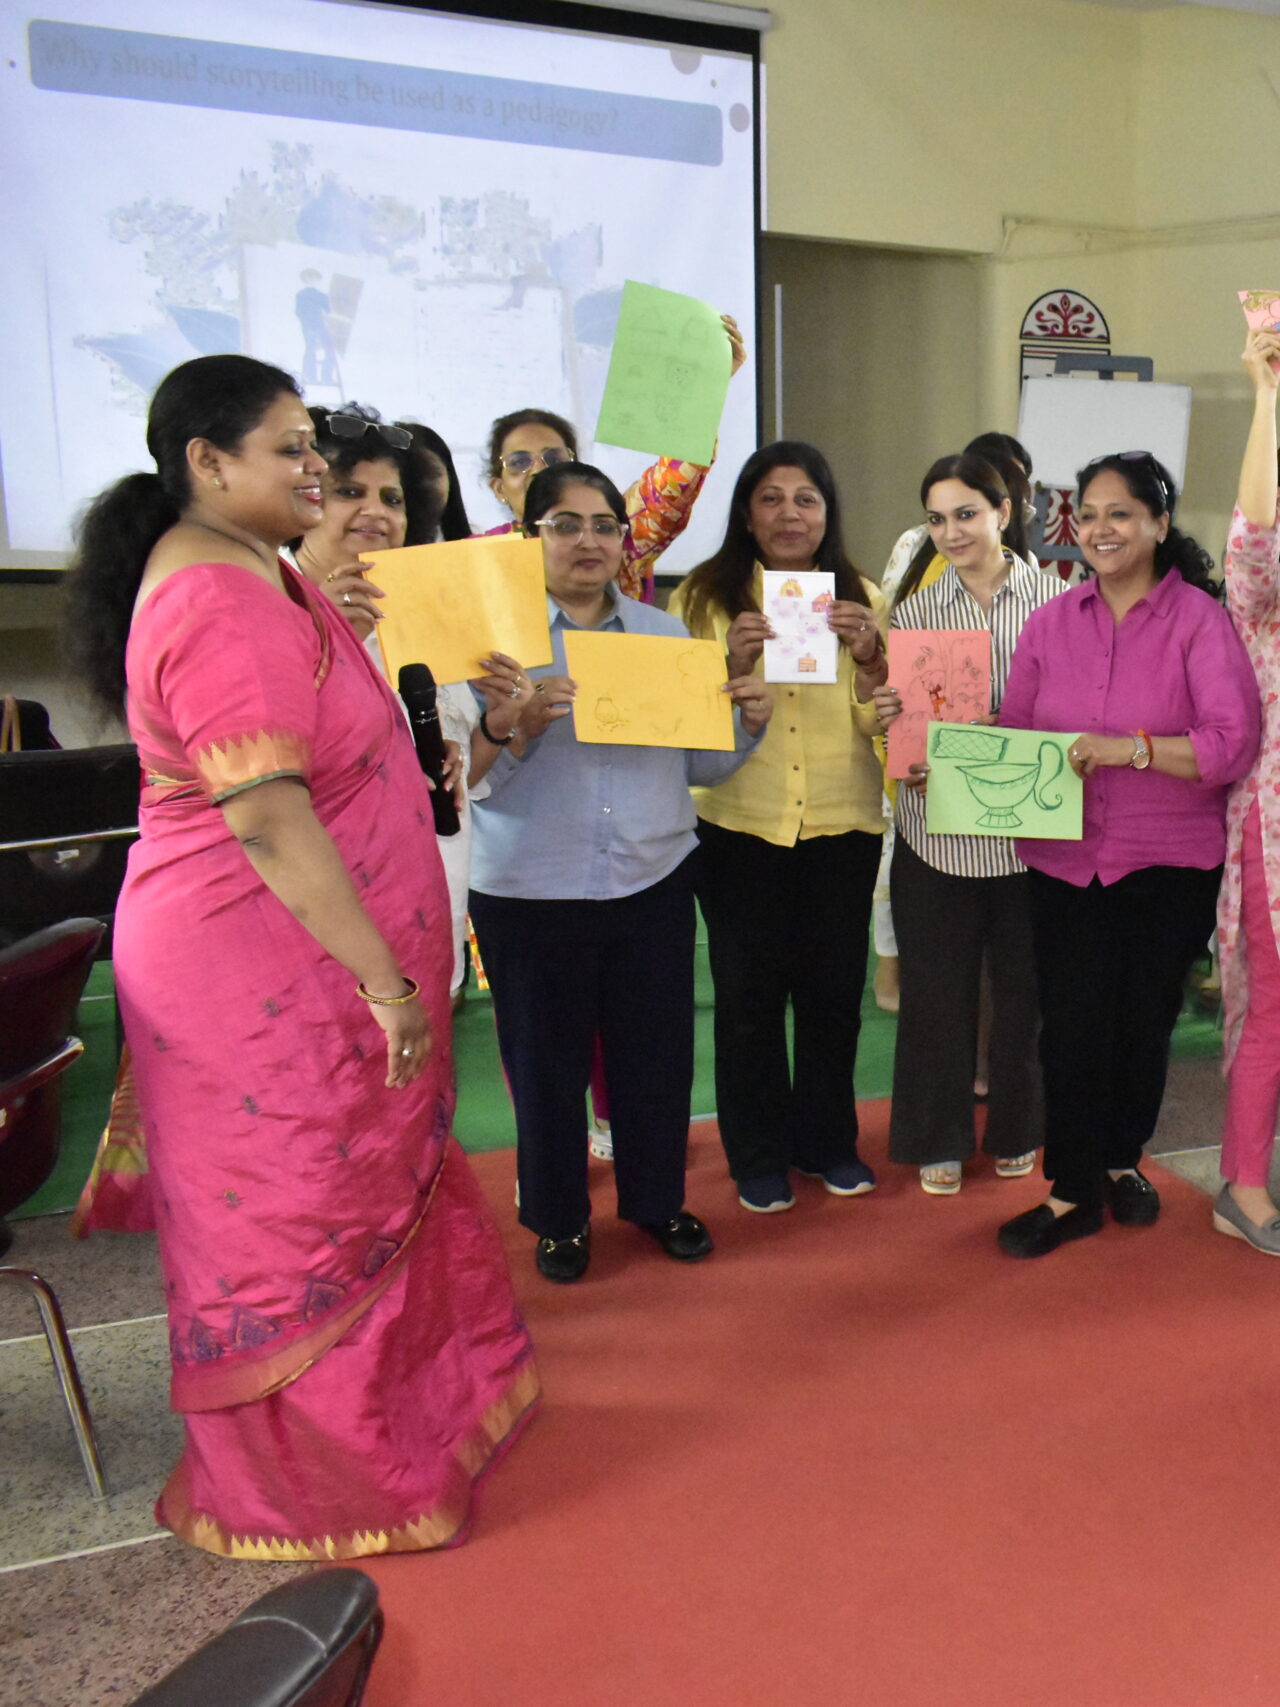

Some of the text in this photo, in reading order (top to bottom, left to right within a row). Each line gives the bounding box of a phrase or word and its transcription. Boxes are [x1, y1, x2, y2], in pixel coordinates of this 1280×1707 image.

[41, 37, 619, 135] Why should storytelling be used as a pedagogy?
